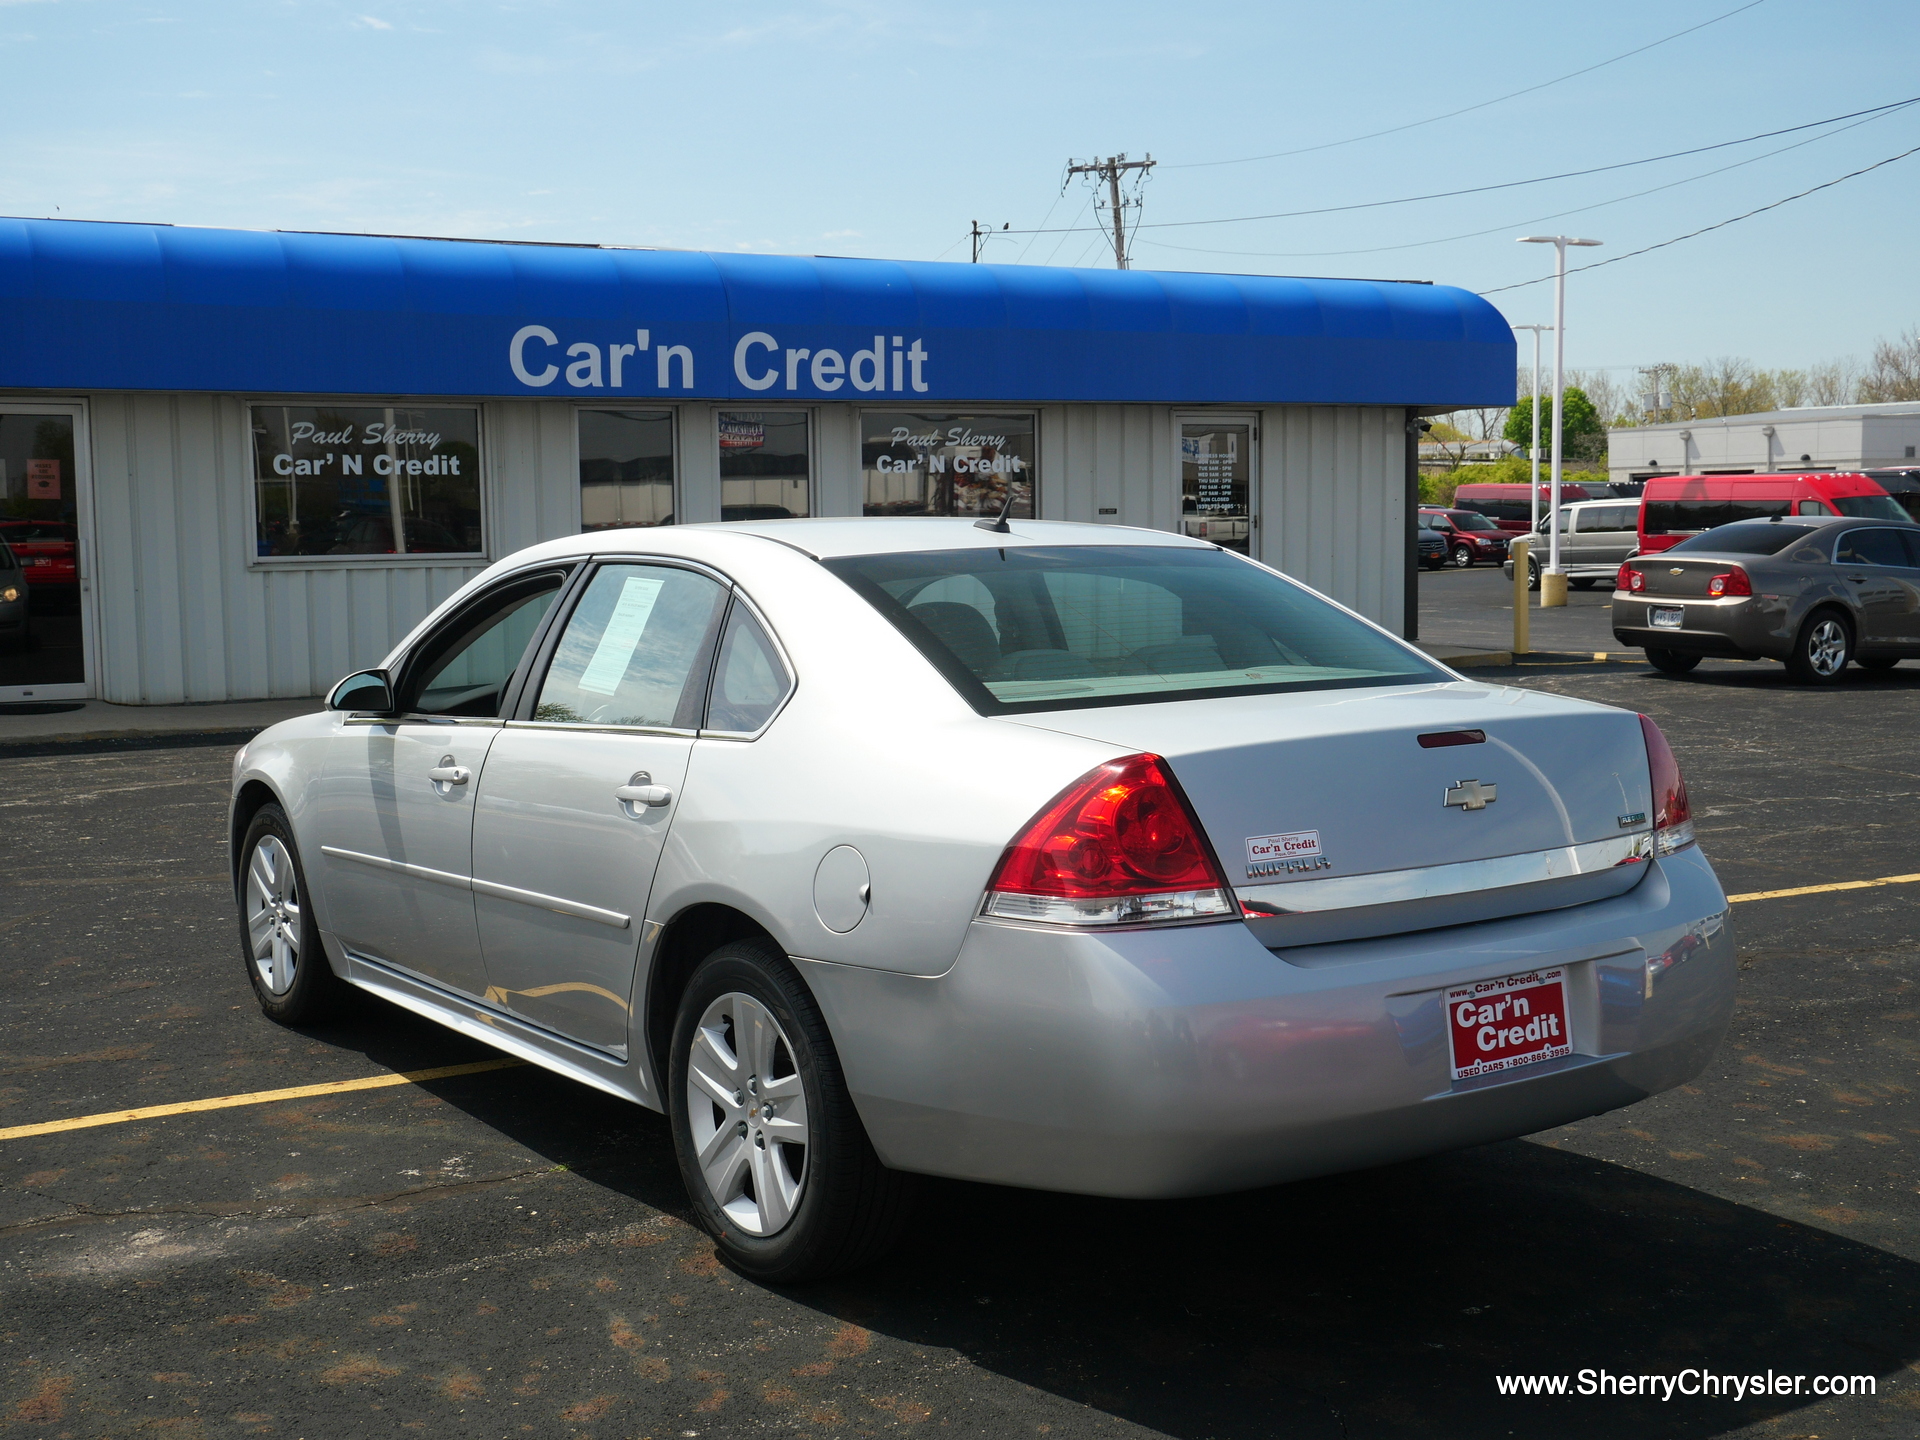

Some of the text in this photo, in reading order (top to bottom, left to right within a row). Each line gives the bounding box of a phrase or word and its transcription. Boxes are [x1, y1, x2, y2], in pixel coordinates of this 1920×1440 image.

[509, 324, 929, 393] Car'n Credit
[291, 421, 442, 451] Paul Sherry
[890, 426, 1006, 451] Paul Sherry
[273, 453, 461, 476] Car' N Credit
[876, 454, 1021, 474] Car' N Credit
[1252, 839, 1317, 854] Car'n Credit
[1245, 856, 1332, 879] IMPALA
[1475, 981, 1505, 993] Car'n
[1507, 972, 1540, 987] Credit
[1456, 994, 1530, 1028] Car'n
[1476, 1013, 1560, 1052] Credit
[1457, 1046, 1570, 1079] USED CARS 1-800-866-3995
